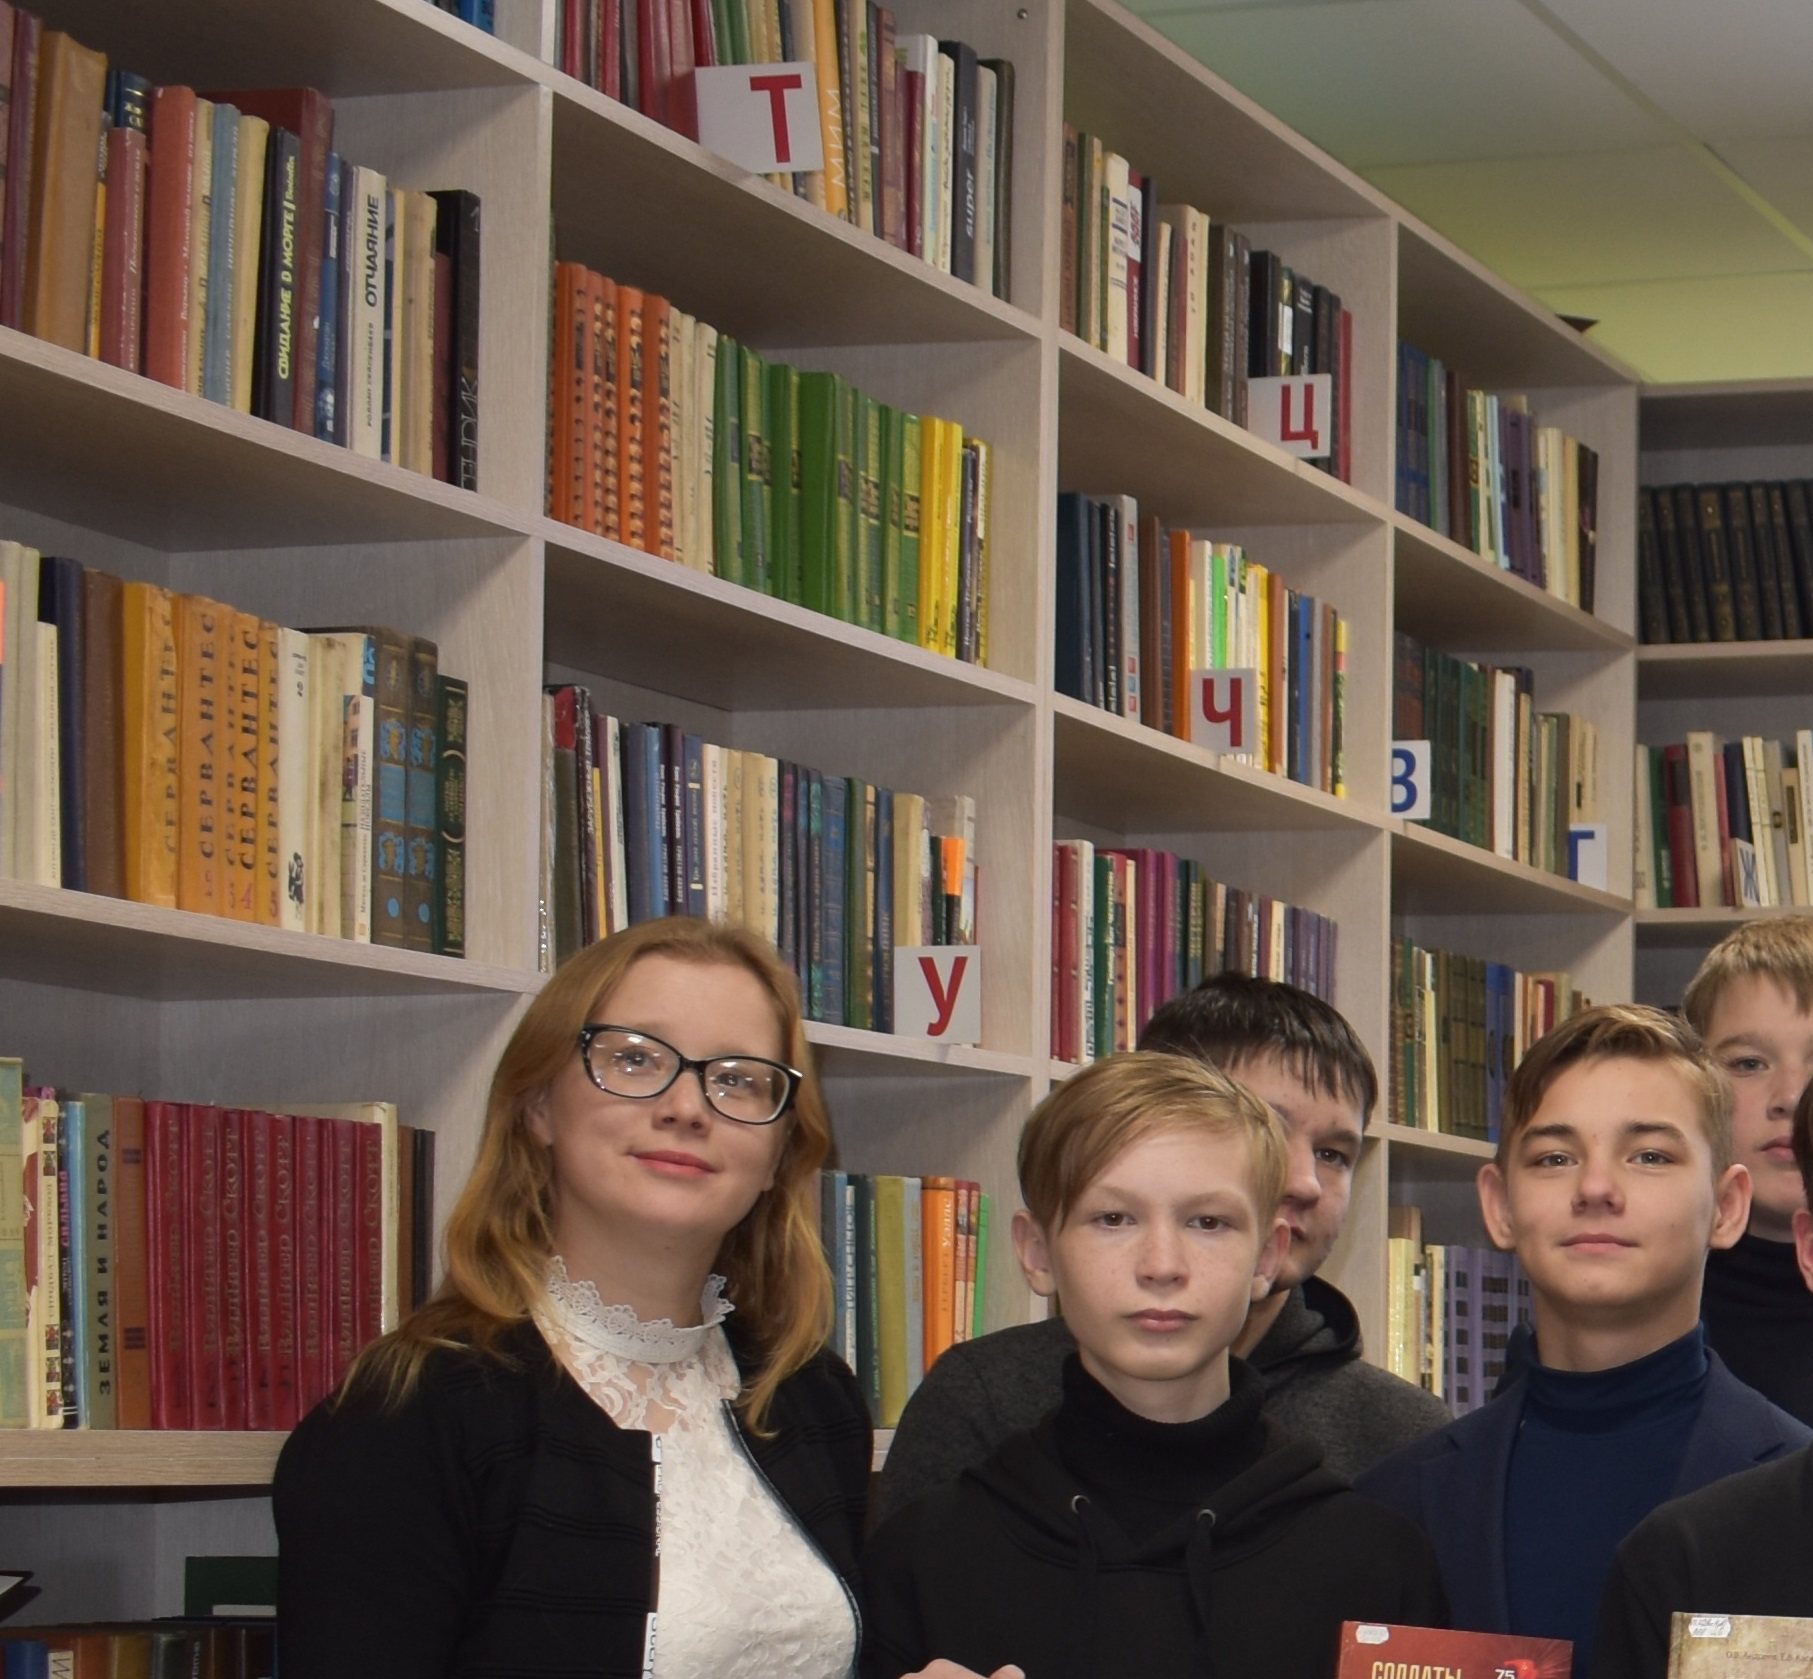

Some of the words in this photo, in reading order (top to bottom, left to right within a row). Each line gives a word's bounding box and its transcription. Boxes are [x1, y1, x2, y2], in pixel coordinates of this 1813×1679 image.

[749, 74, 802, 163] Т
[281, 209, 295, 269] МОРГЕ
[964, 169, 976, 239] super
[364, 194, 381, 308] ОТЧАЯНИЕ
[278, 289, 293, 380] СВИДАНИЕ
[1280, 383, 1319, 450] Ц
[199, 611, 216, 859] СЕРВАНТЕС
[240, 628, 259, 871] СЕРВАНТЕС
[1200, 678, 1243, 747] Ч
[240, 883, 255, 908] 4
[1570, 831, 1595, 879] Г
[917, 955, 969, 1036] У
[96, 1129, 110, 1240] НАРОД
[224, 1128, 238, 1220] СКОТТ
[97, 1257, 110, 1274] И
[225, 1229, 242, 1356] ВАЛЬТЕР
[97, 1290, 111, 1395] ЗЕМЛЯ
